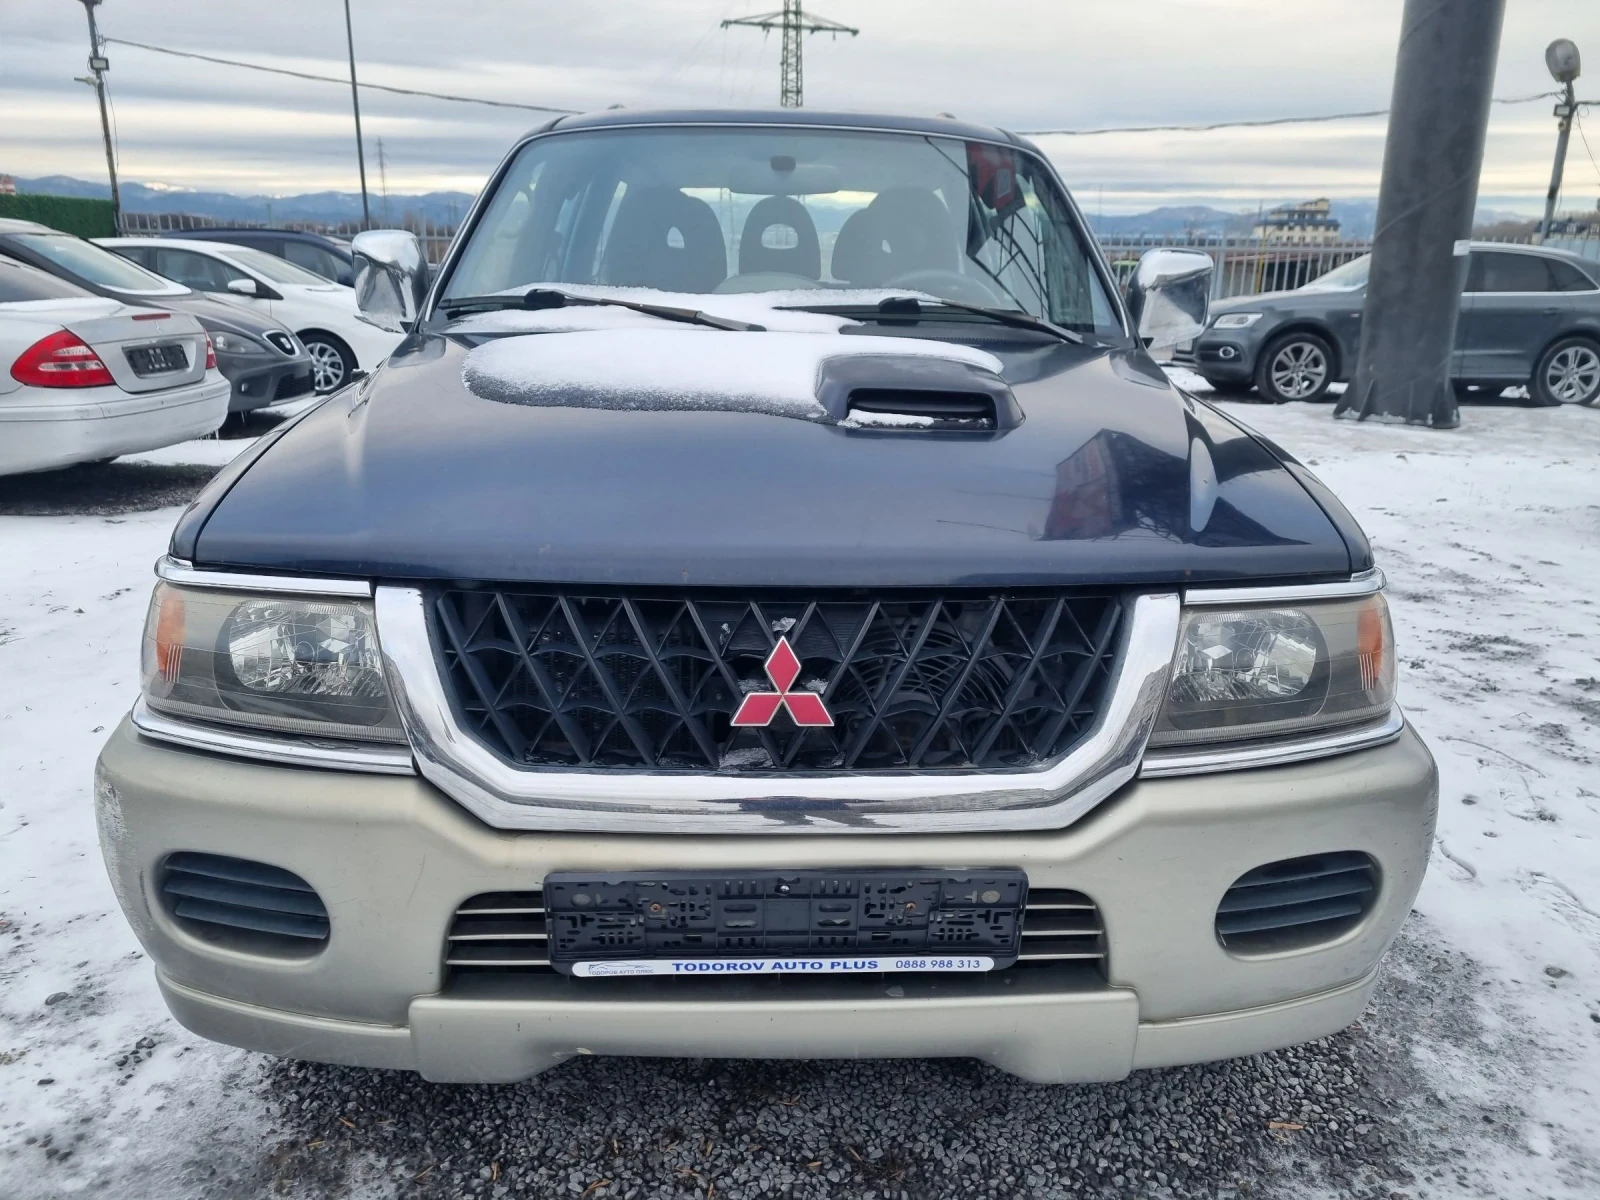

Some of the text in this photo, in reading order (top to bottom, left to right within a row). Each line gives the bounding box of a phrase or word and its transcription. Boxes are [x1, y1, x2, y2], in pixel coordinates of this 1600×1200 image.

[672, 959, 981, 972] TODOROV AUTO PLUS 0888 988 313
